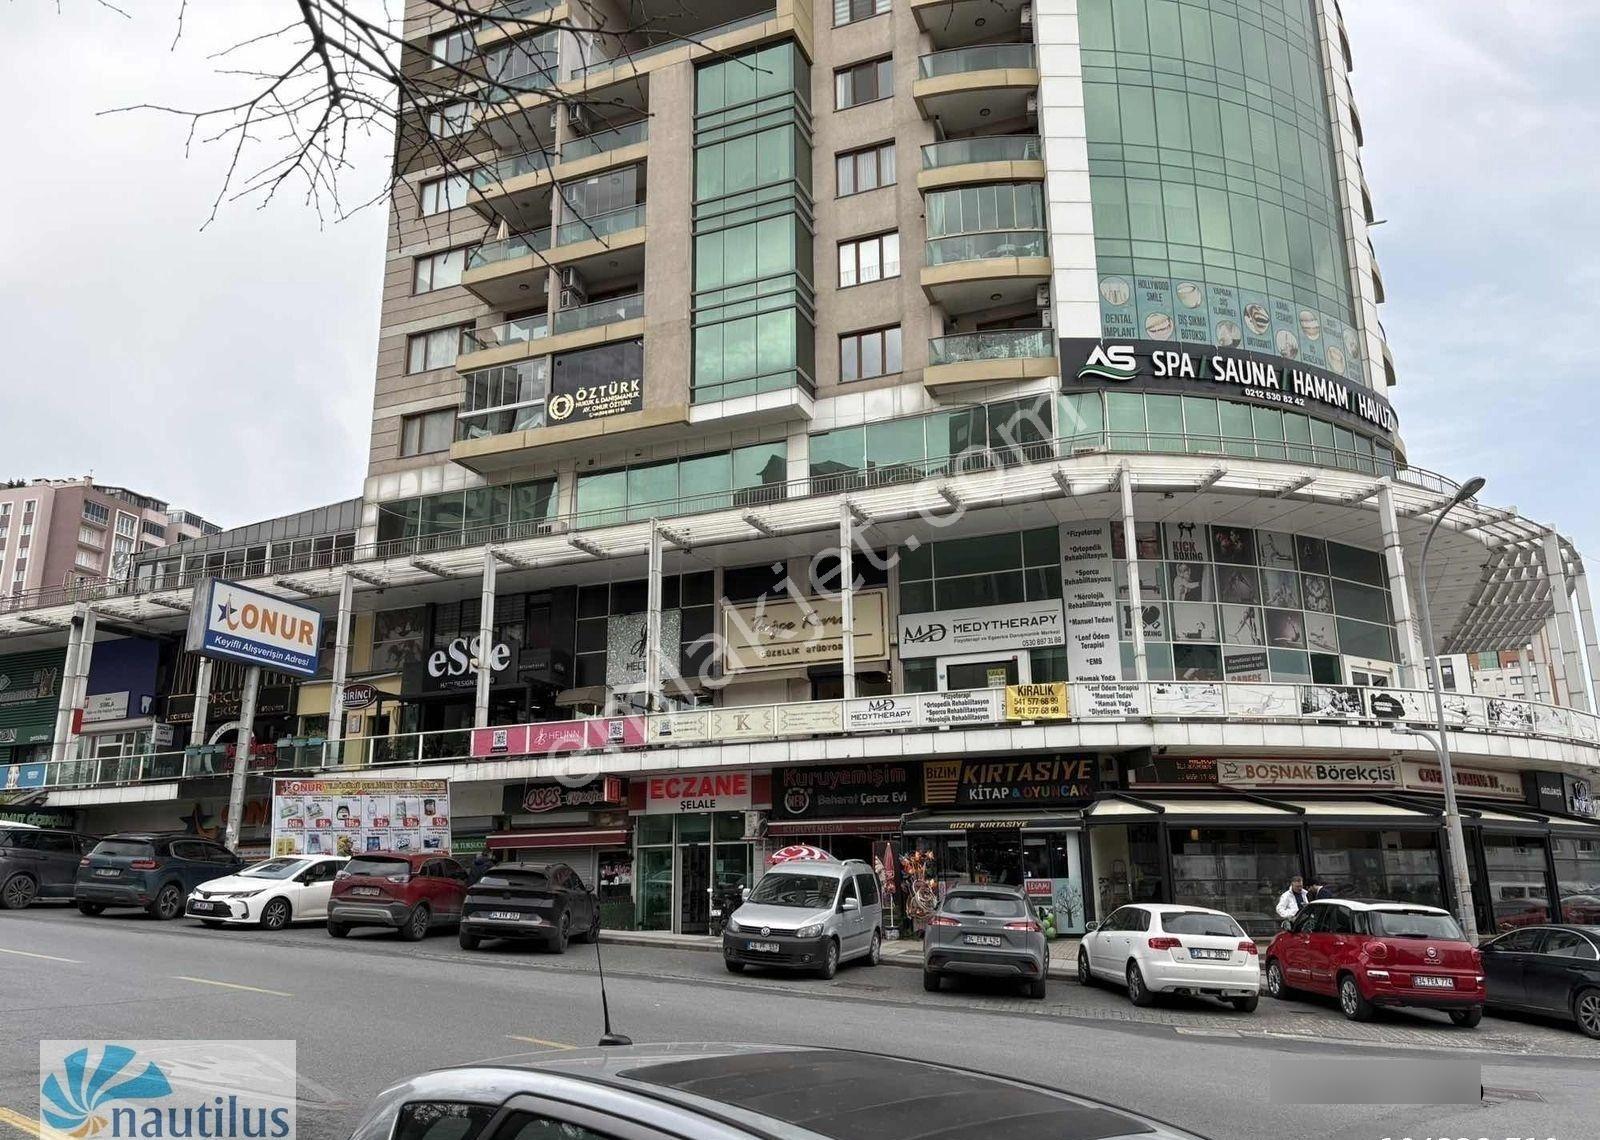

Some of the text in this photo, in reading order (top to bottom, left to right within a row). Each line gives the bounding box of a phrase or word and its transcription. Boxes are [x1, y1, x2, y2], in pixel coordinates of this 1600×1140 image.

[1105, 313, 1132, 325] DENTAL
[575, 378, 640, 401] ÖZTÜRK
[1152, 350, 1196, 379] SPA
[1213, 356, 1280, 390] SAUNA
[1293, 368, 1350, 410] HAMAM
[1357, 392, 1395, 433] HAVUZ
[1245, 387, 1305, 407] 0212 530 82 42
[592, 402, 609, 411] ONUR
[1172, 541, 1196, 552] KICK
[1173, 552, 1204, 561] BOXING
[241, 603, 314, 646] ONUR
[953, 614, 1058, 634] MEDYTHERAPY
[214, 635, 310, 666] Keyifli Alışverişin Adresi
[1021, 639, 1036, 647] 0530
[1014, 698, 1026, 706] 541
[1027, 697, 1039, 705] 577
[850, 710, 912, 721] MEDYTHERAPY
[1014, 707, 1026, 715] 541
[1027, 706, 1039, 714] 577
[963, 755, 1094, 785] KIRTASİYE
[1245, 764, 1396, 785] BOŞNAK Börekçisi
[292, 782, 324, 793] ONUR
[650, 774, 748, 800] ECZANE
[969, 785, 1090, 801] KİTAP & OYUNCAK
[680, 799, 716, 812] ŞELALE
[860, 792, 890, 806] Çerez
[892, 791, 908, 804] Evi
